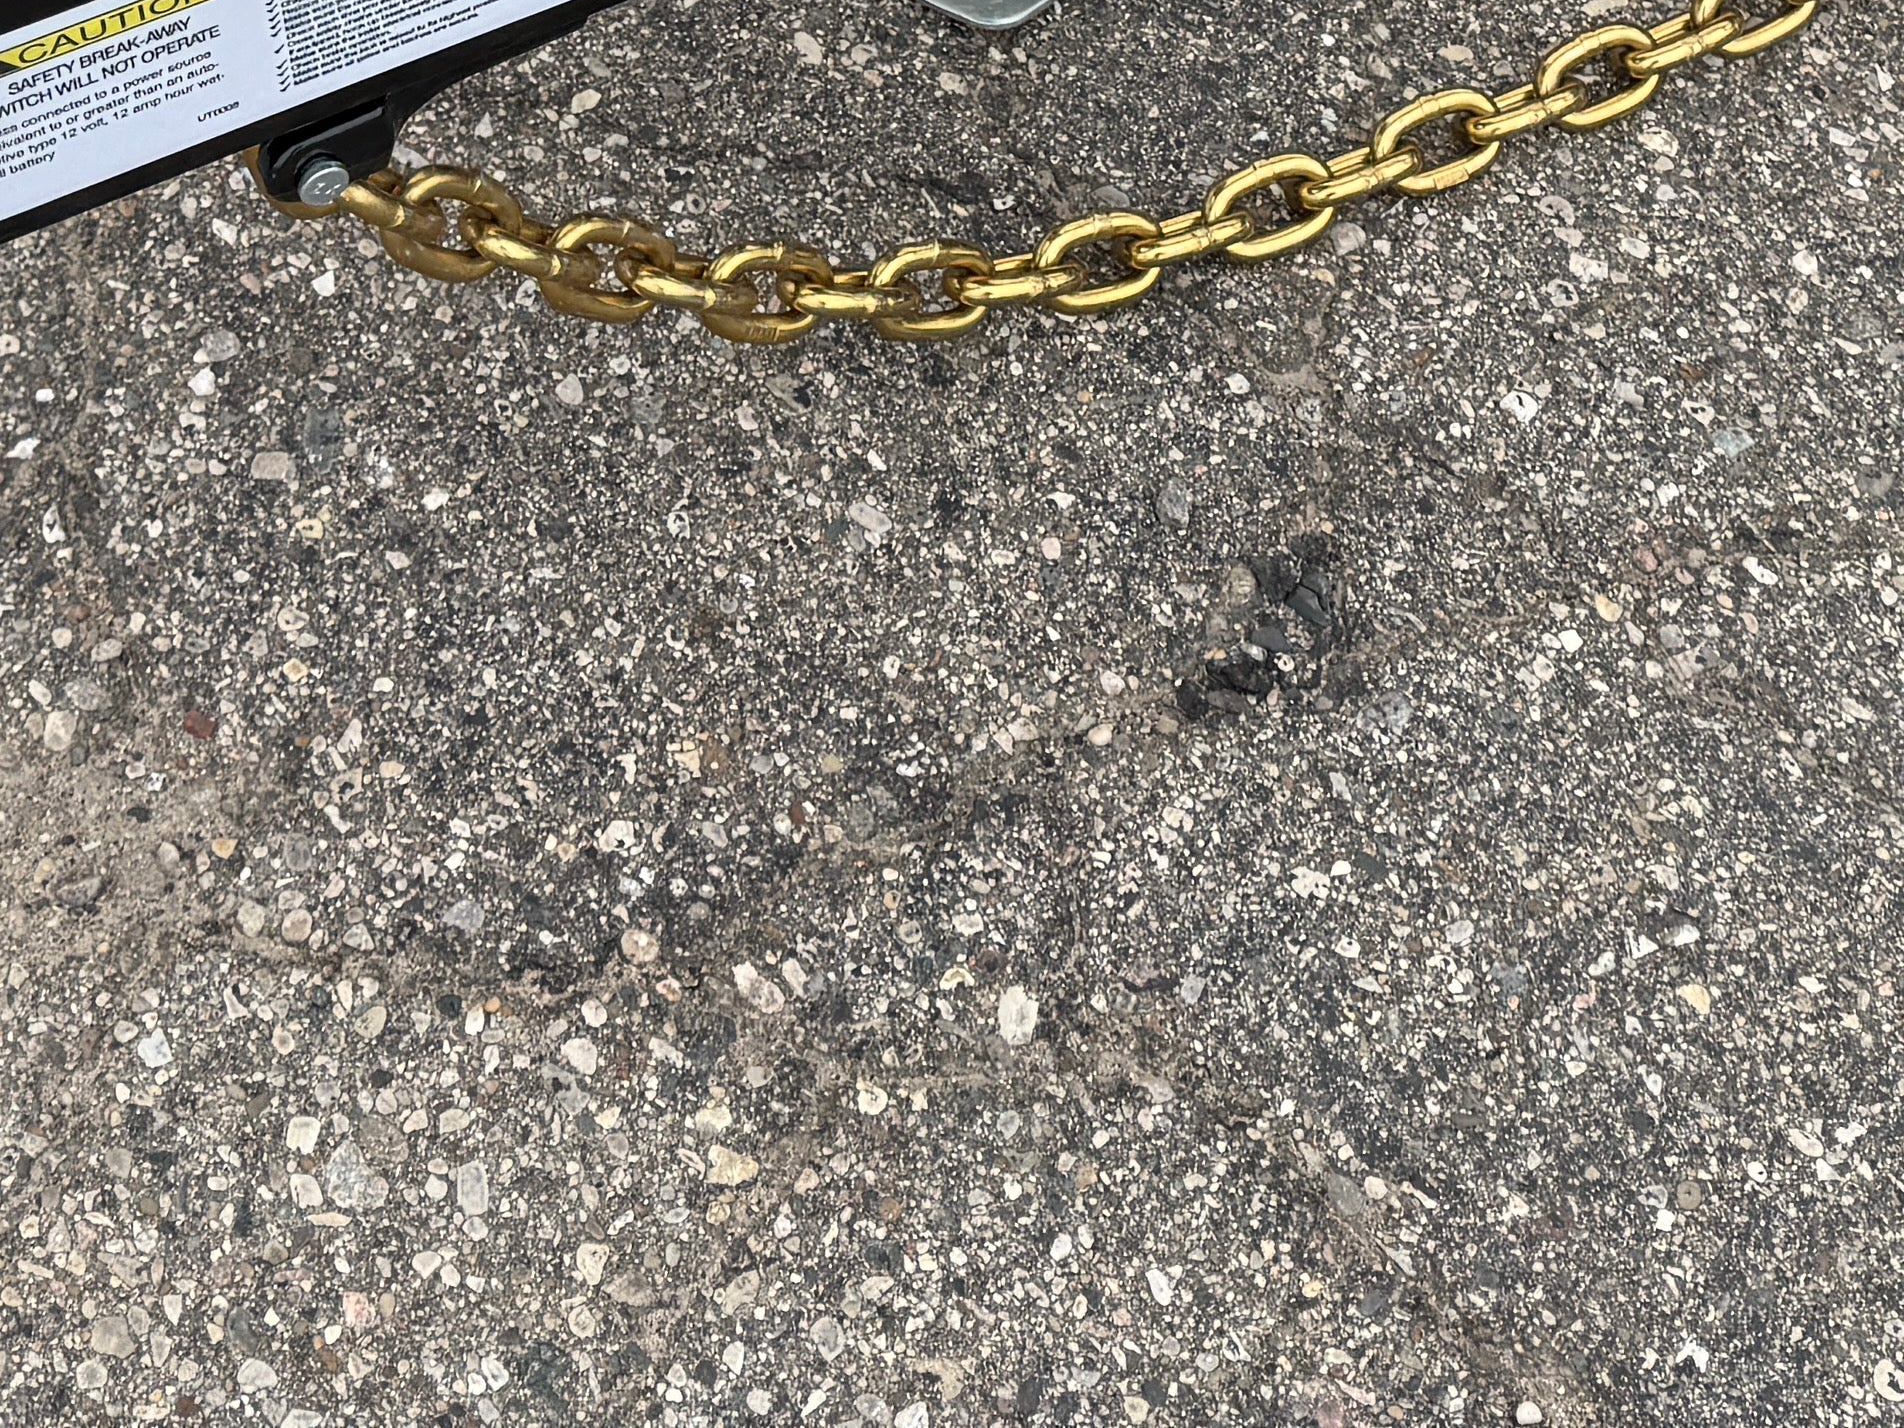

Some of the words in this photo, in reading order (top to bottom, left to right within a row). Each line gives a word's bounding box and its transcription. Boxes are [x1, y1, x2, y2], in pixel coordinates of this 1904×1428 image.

[8, 60, 74, 95] SAFETY
[79, 16, 190, 68] BREAK-AWAY
[22, 95, 90, 128] connected
[95, 91, 107, 100] to
[112, 86, 119, 94] a
[123, 69, 163, 91] power
[168, 52, 211, 72] source
[57, 73, 99, 95] WILL
[102, 55, 137, 79] NOT
[141, 25, 220, 63] OPERATE
[28, 138, 56, 154] type
[61, 128, 77, 139] 12
[113, 109, 128, 120] 12
[133, 98, 161, 113] amp
[165, 84, 193, 100] hour
[49, 122, 62, 131] to
[66, 115, 78, 125] or
[83, 95, 129, 120] greater
[133, 83, 162, 99] than
[167, 76, 183, 86] an
[187, 64, 219, 79] auto-
[9, 152, 55, 174] battery
